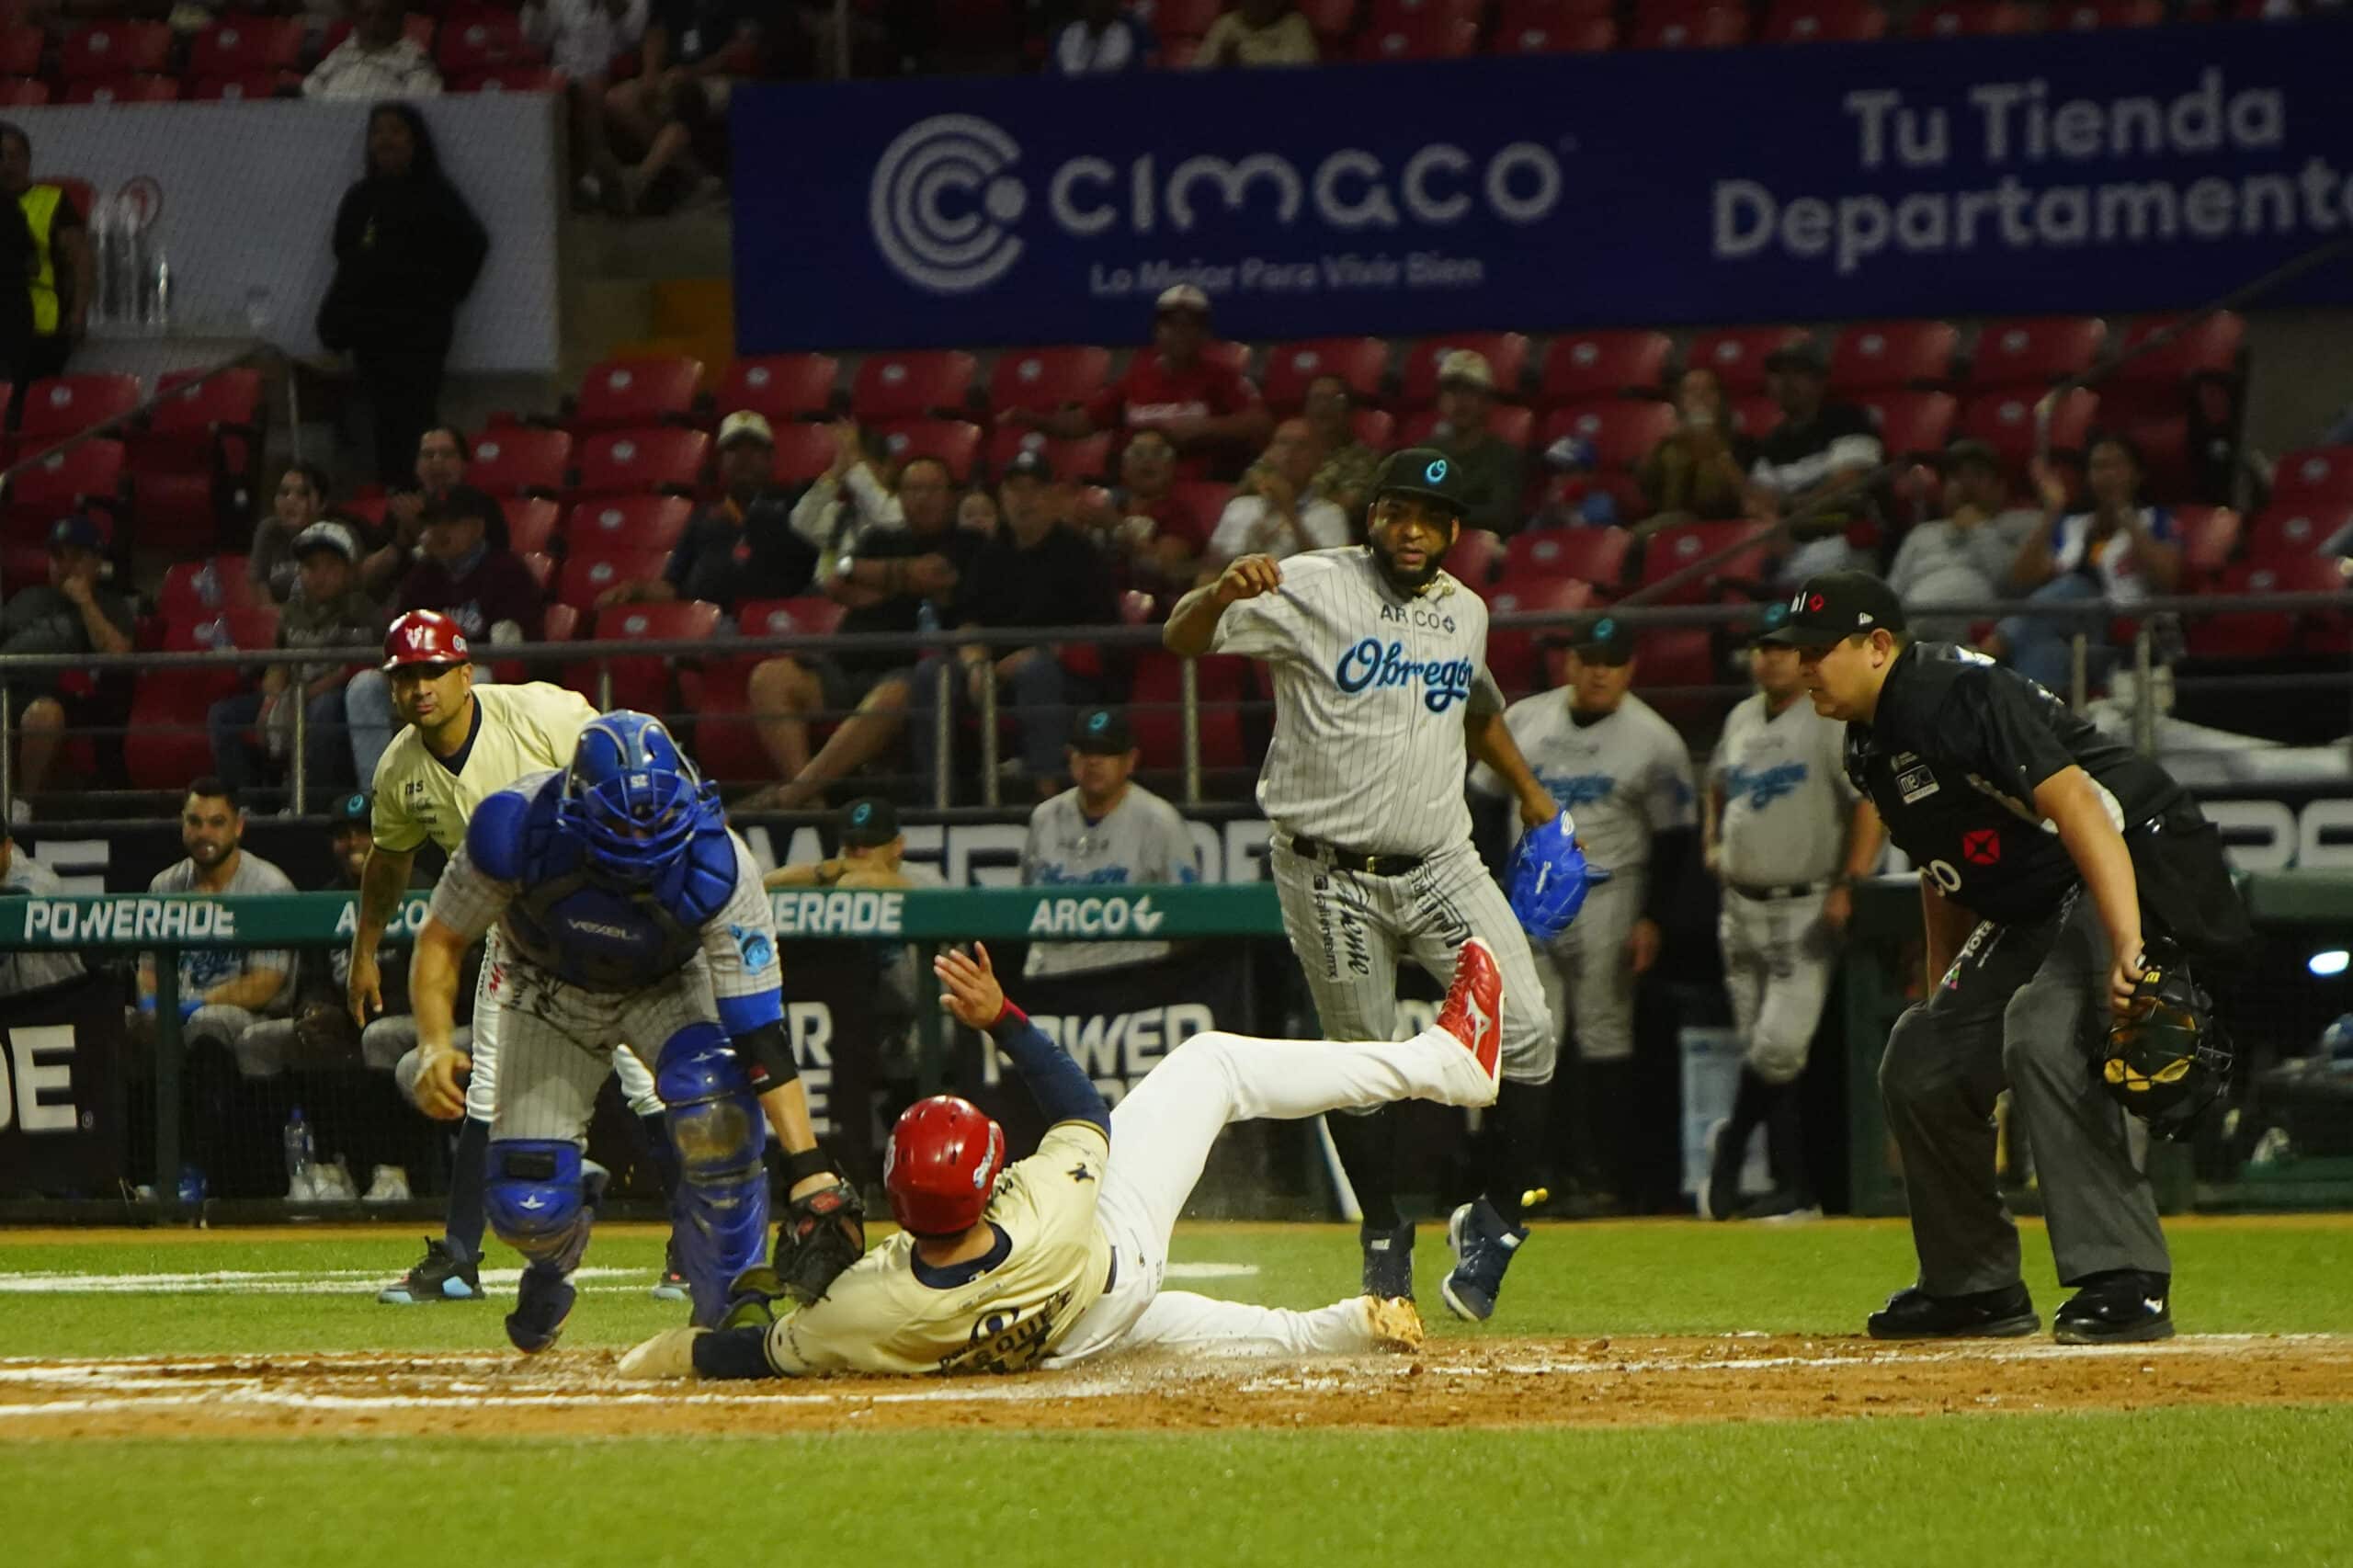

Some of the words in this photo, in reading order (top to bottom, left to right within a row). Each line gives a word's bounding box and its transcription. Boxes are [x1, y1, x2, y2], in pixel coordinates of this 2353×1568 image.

[1842, 89, 1949, 169] Tu
[1967, 66, 2287, 166] Tienda
[1240, 257, 1319, 291] Para
[24, 898, 237, 942] POWERADE
[334, 898, 432, 936] ACO
[769, 890, 905, 936] ERADE
[1027, 895, 1131, 936] ARCO
